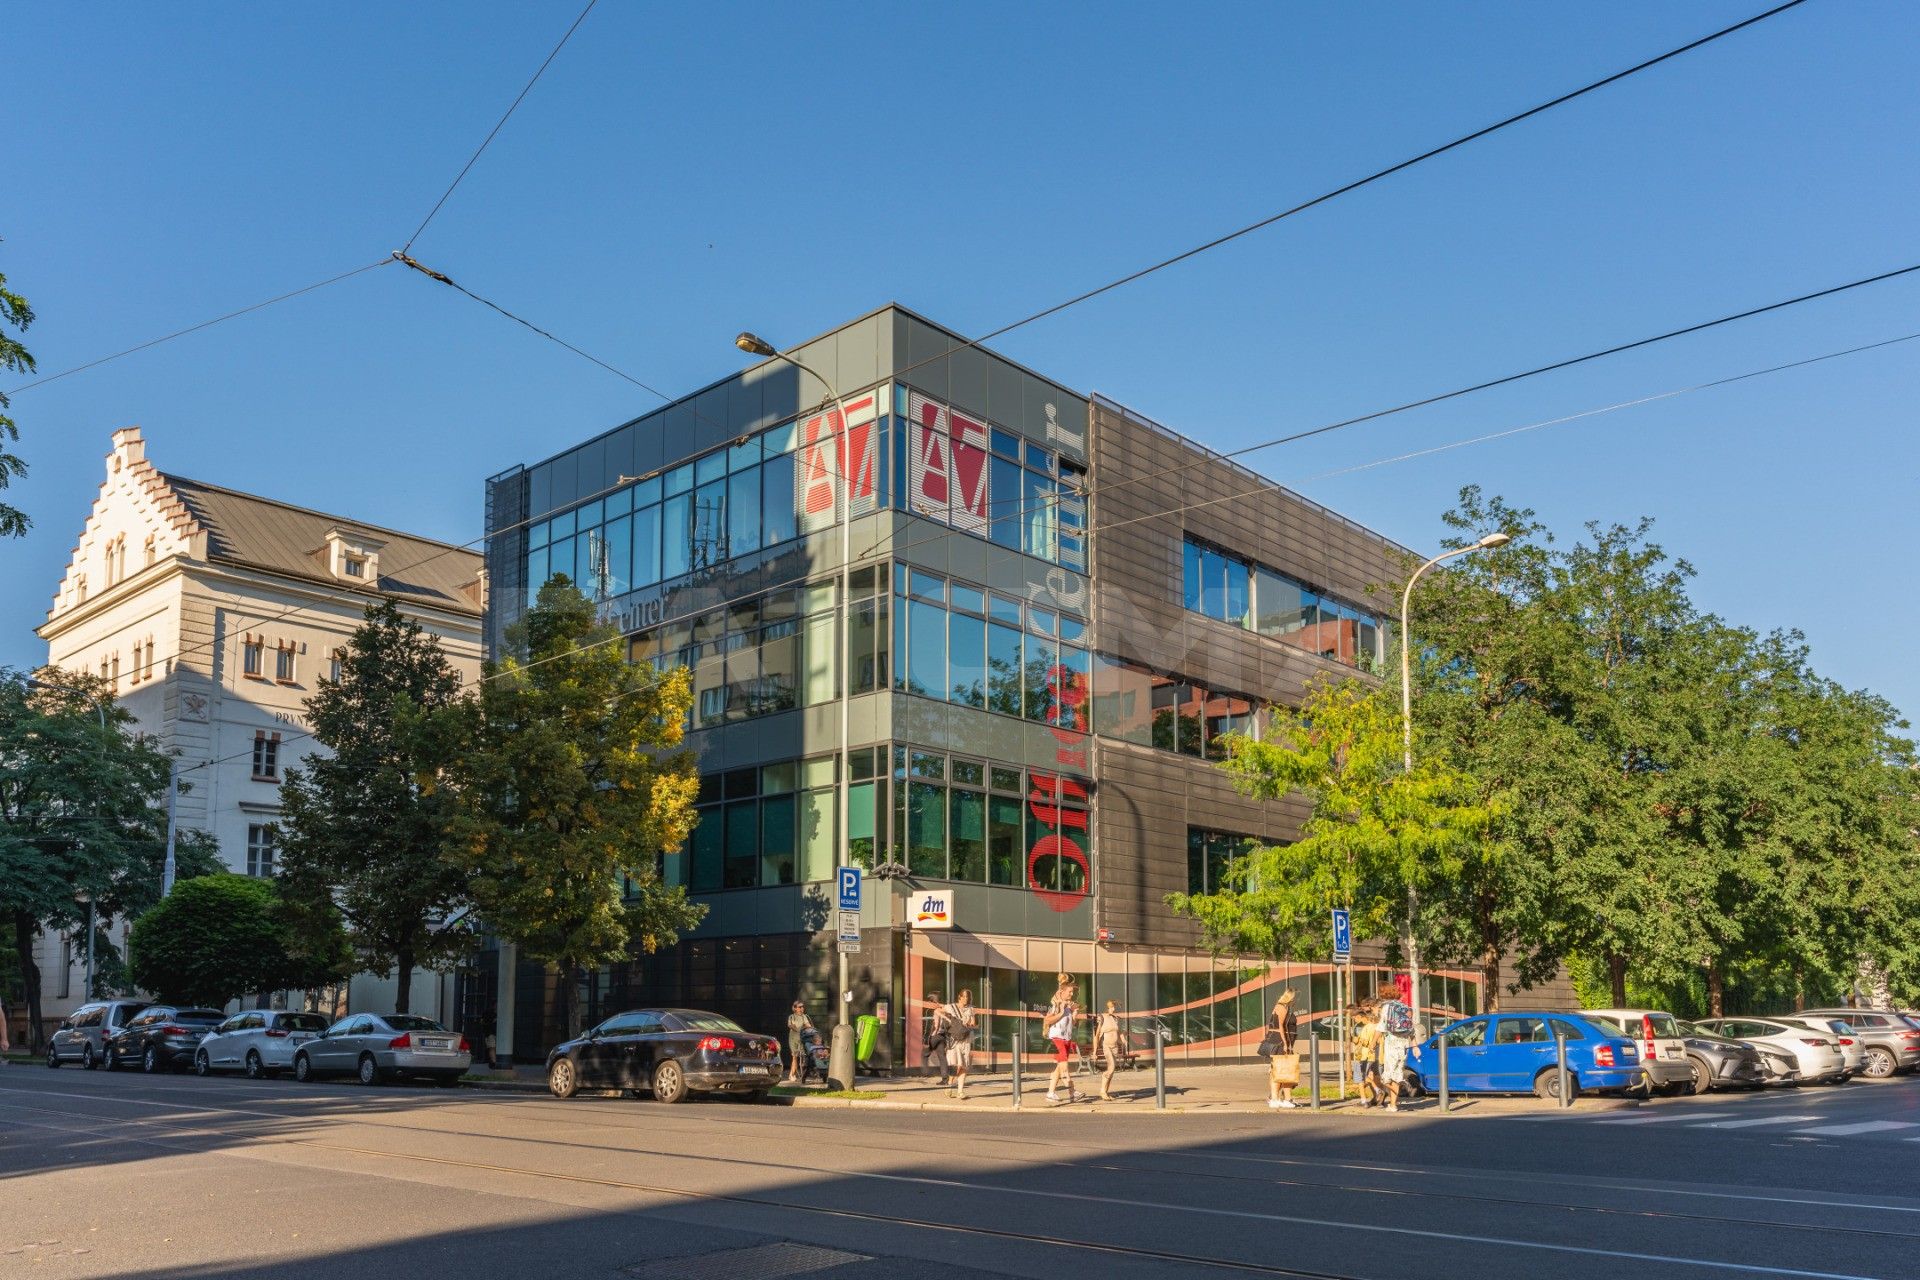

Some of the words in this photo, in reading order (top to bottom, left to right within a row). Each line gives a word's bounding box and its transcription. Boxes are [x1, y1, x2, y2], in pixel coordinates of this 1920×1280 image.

[1026, 402, 1089, 657] Center
[1027, 664, 1090, 913] Office
[843, 872, 857, 897] P
[922, 895, 944, 913] dm
[1337, 915, 1346, 940] P
